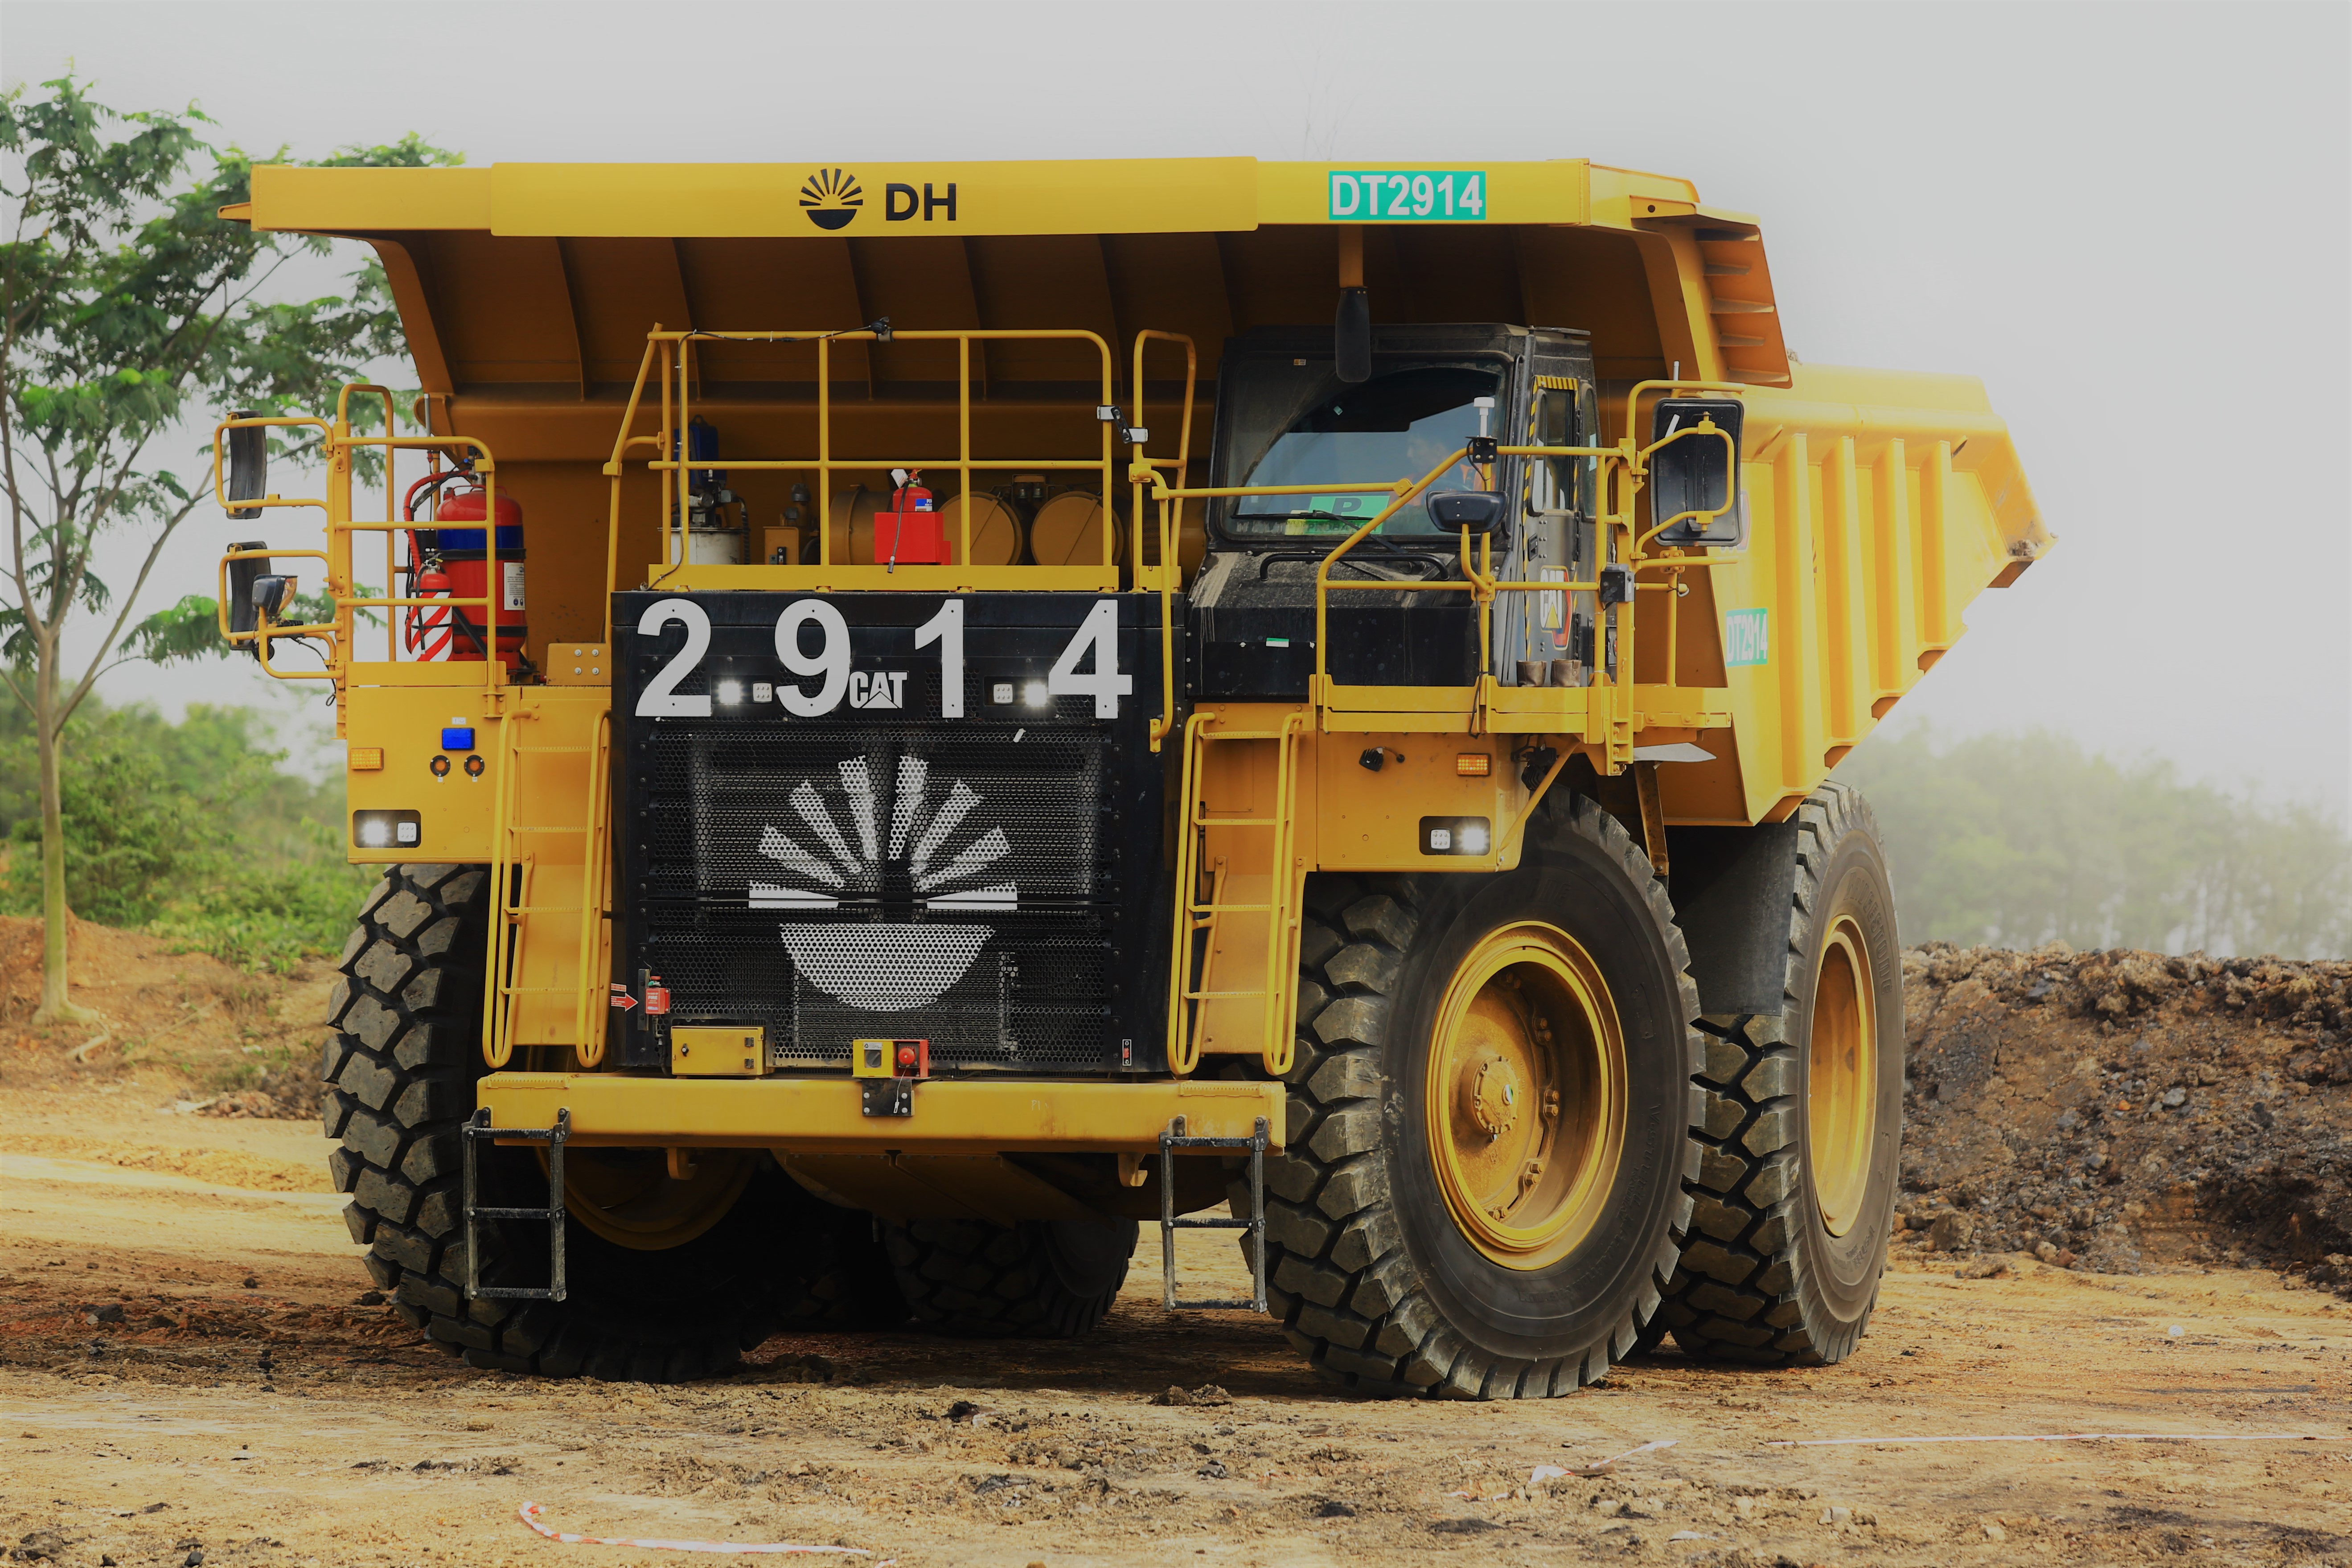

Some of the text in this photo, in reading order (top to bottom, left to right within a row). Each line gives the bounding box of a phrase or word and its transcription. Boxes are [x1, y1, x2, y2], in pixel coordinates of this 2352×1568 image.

[885, 183, 956, 221] DH
[1332, 174, 1483, 216] DT2914
[1331, 497, 1362, 516] P
[1540, 569, 1564, 628] CAT
[1726, 613, 1768, 663] DT2914
[849, 671, 908, 709] CAT
